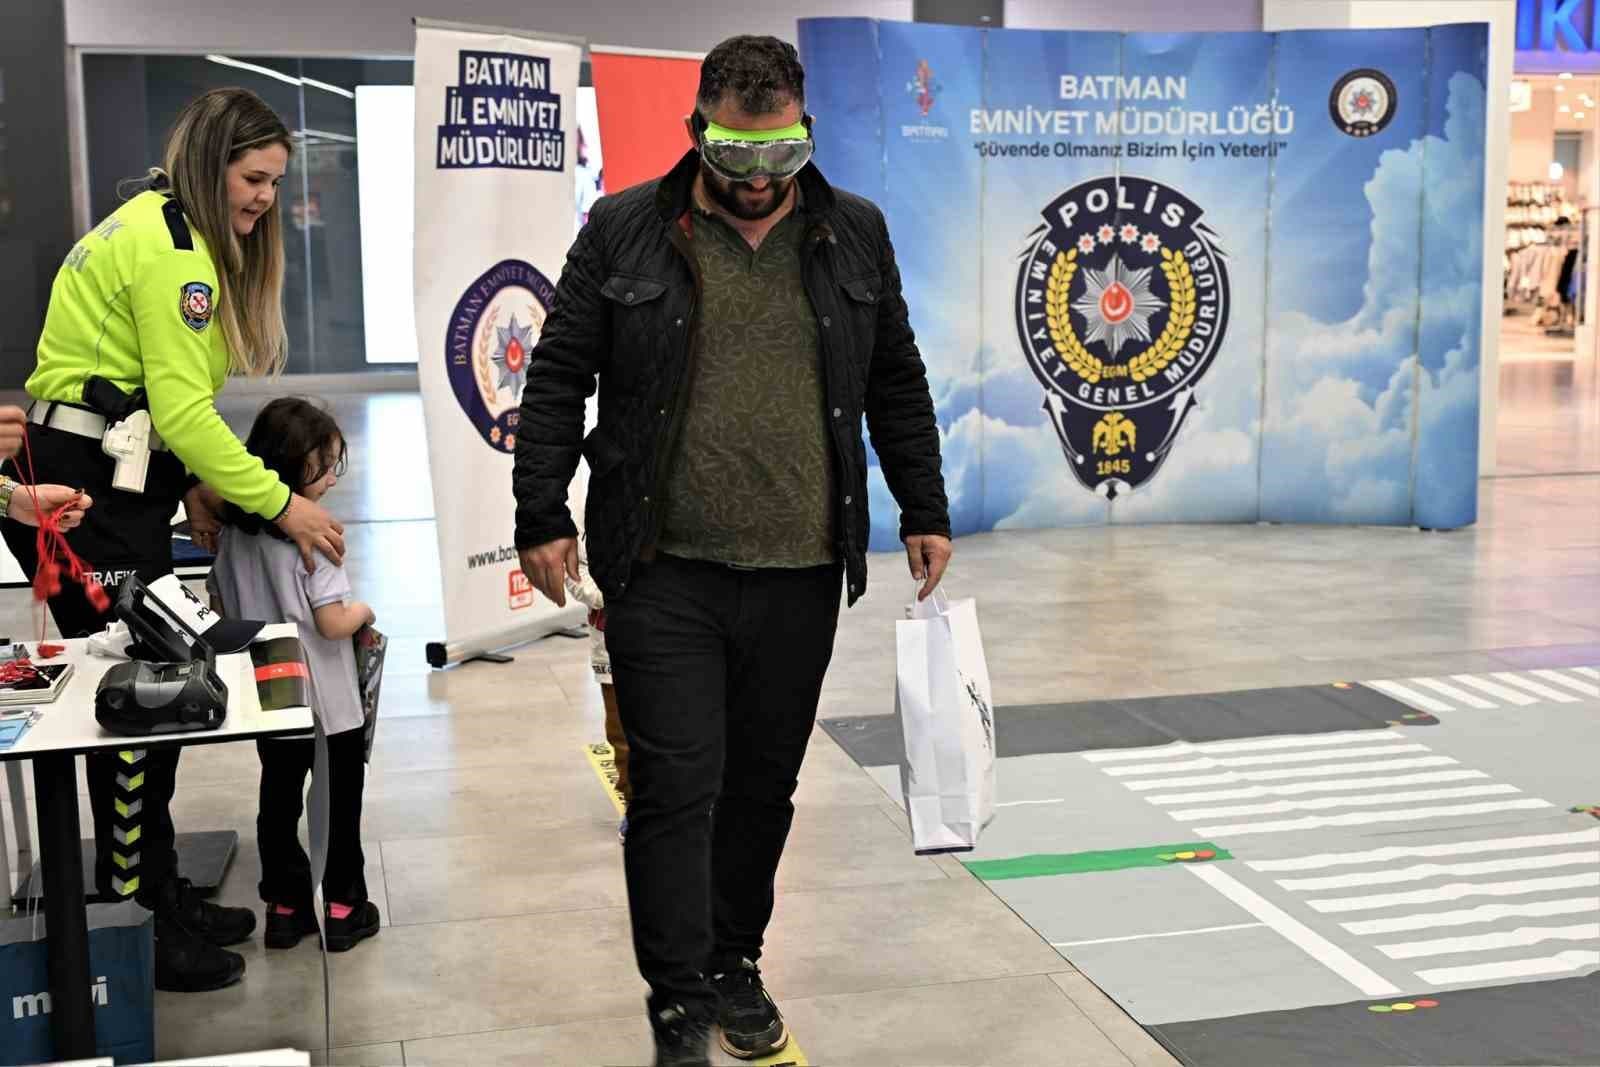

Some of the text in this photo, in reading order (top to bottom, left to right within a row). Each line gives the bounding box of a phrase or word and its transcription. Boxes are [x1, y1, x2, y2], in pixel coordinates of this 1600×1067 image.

[464, 56, 545, 90] BATMAN
[1059, 75, 1187, 100] BATMAN
[450, 90, 558, 130] İL EMNİYET
[969, 104, 1295, 136] EMNİYET MÜDÜRLÜĞÜ
[439, 130, 562, 168] MÜDÜRLÜĞÜ
[1053, 142, 1123, 157] Olmanız
[1127, 142, 1177, 157] Bizim
[1182, 140, 1215, 164] İçin
[1058, 186, 1185, 228] POLİS
[453, 293, 483, 366] BATMAN
[1027, 239, 1217, 403] EMNİYET GENEL MÜDÜRLÜĞÜ
[1096, 459, 1131, 476] 1845
